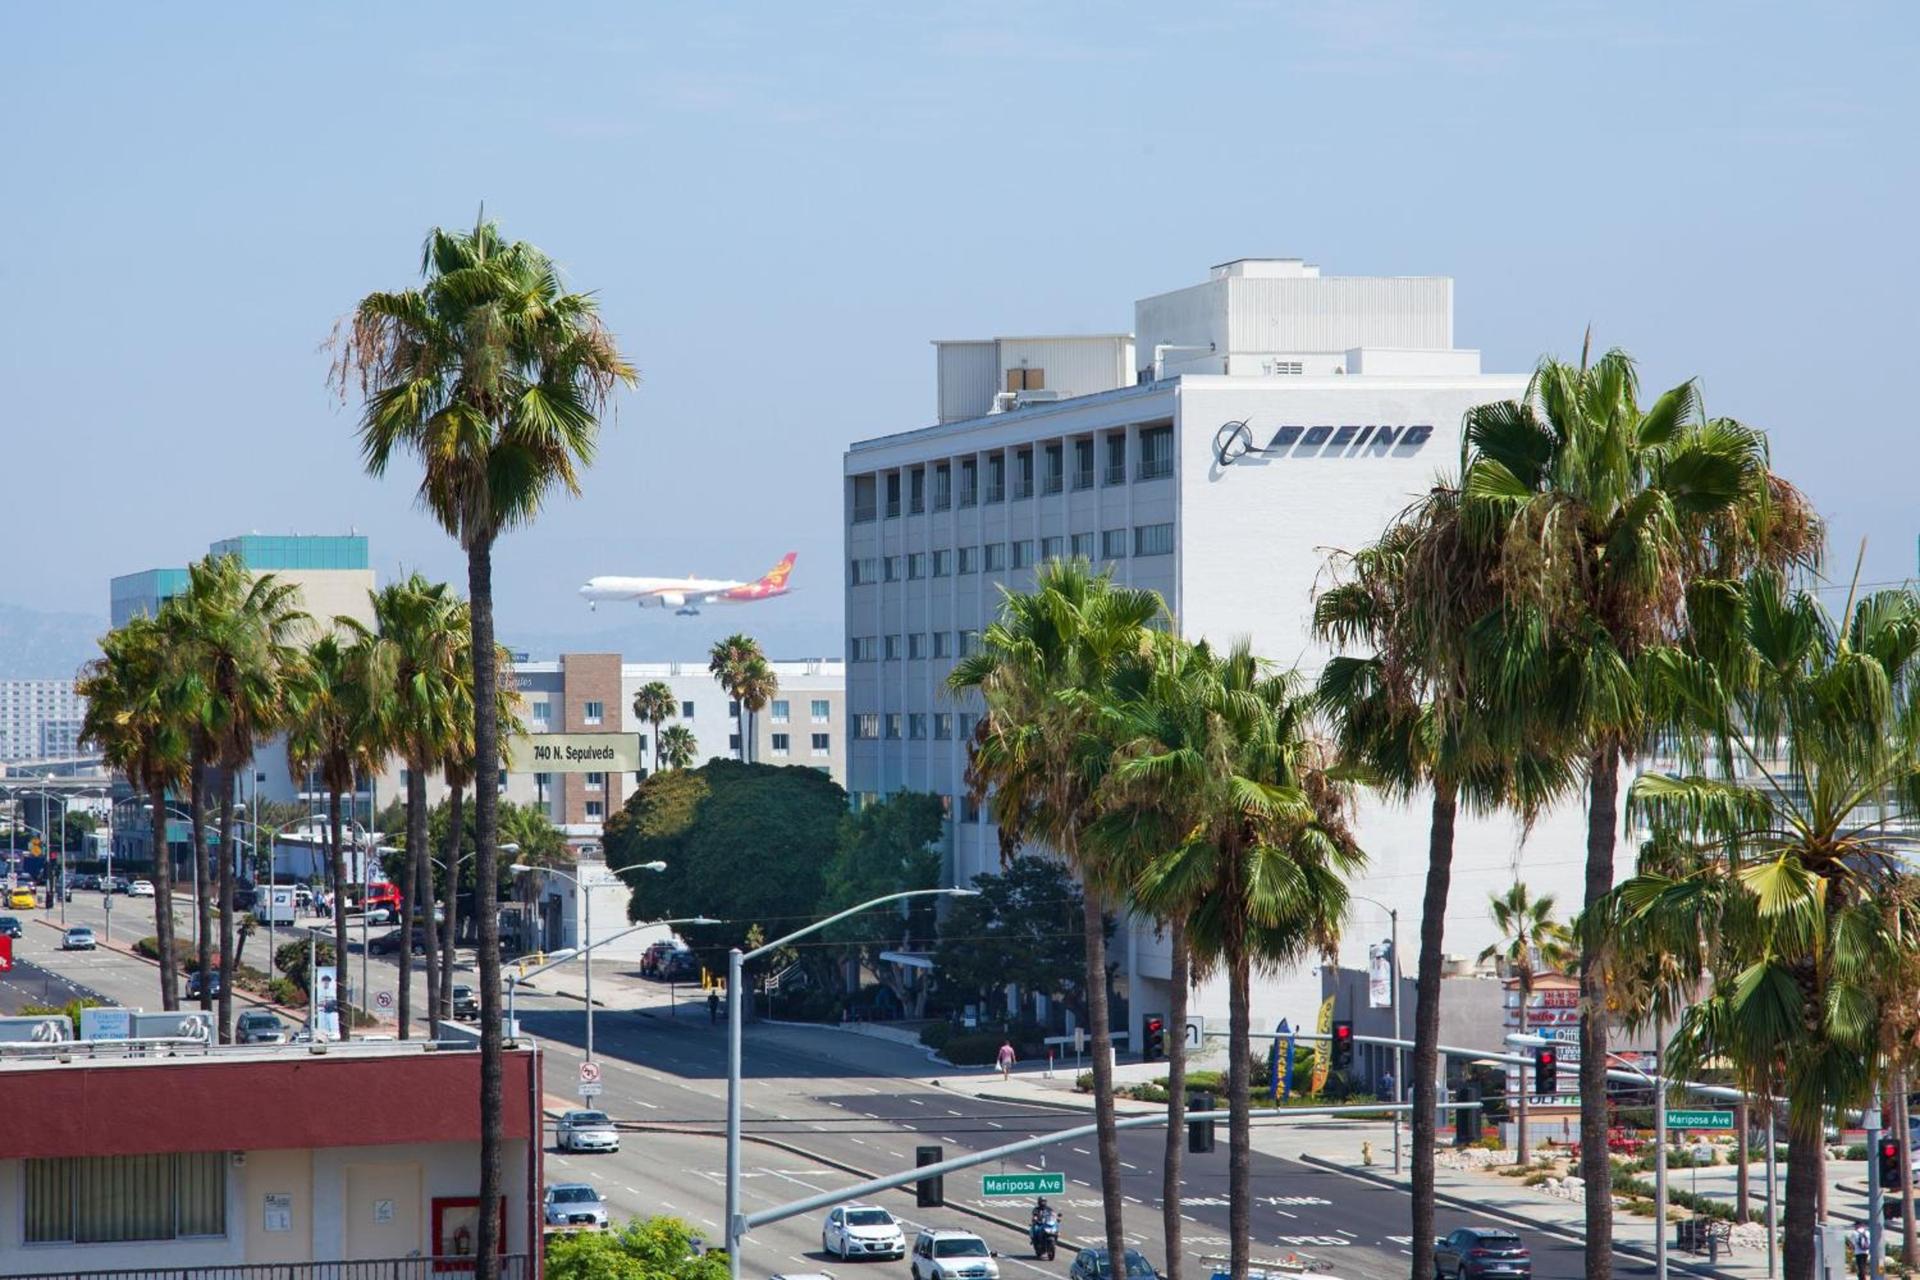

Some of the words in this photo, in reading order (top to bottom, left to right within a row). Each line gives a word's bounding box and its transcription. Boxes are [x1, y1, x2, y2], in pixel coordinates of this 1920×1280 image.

[1268, 425, 1434, 446] BOEING
[534, 745, 550, 759] 740
[553, 745, 562, 759] N.
[565, 745, 614, 763] Sepulveda
[1668, 1115, 1709, 1126] Mariposa
[1711, 1115, 1729, 1125] Ave
[986, 1180, 1035, 1193] Mariposa
[1038, 1179, 1060, 1189] Ave
